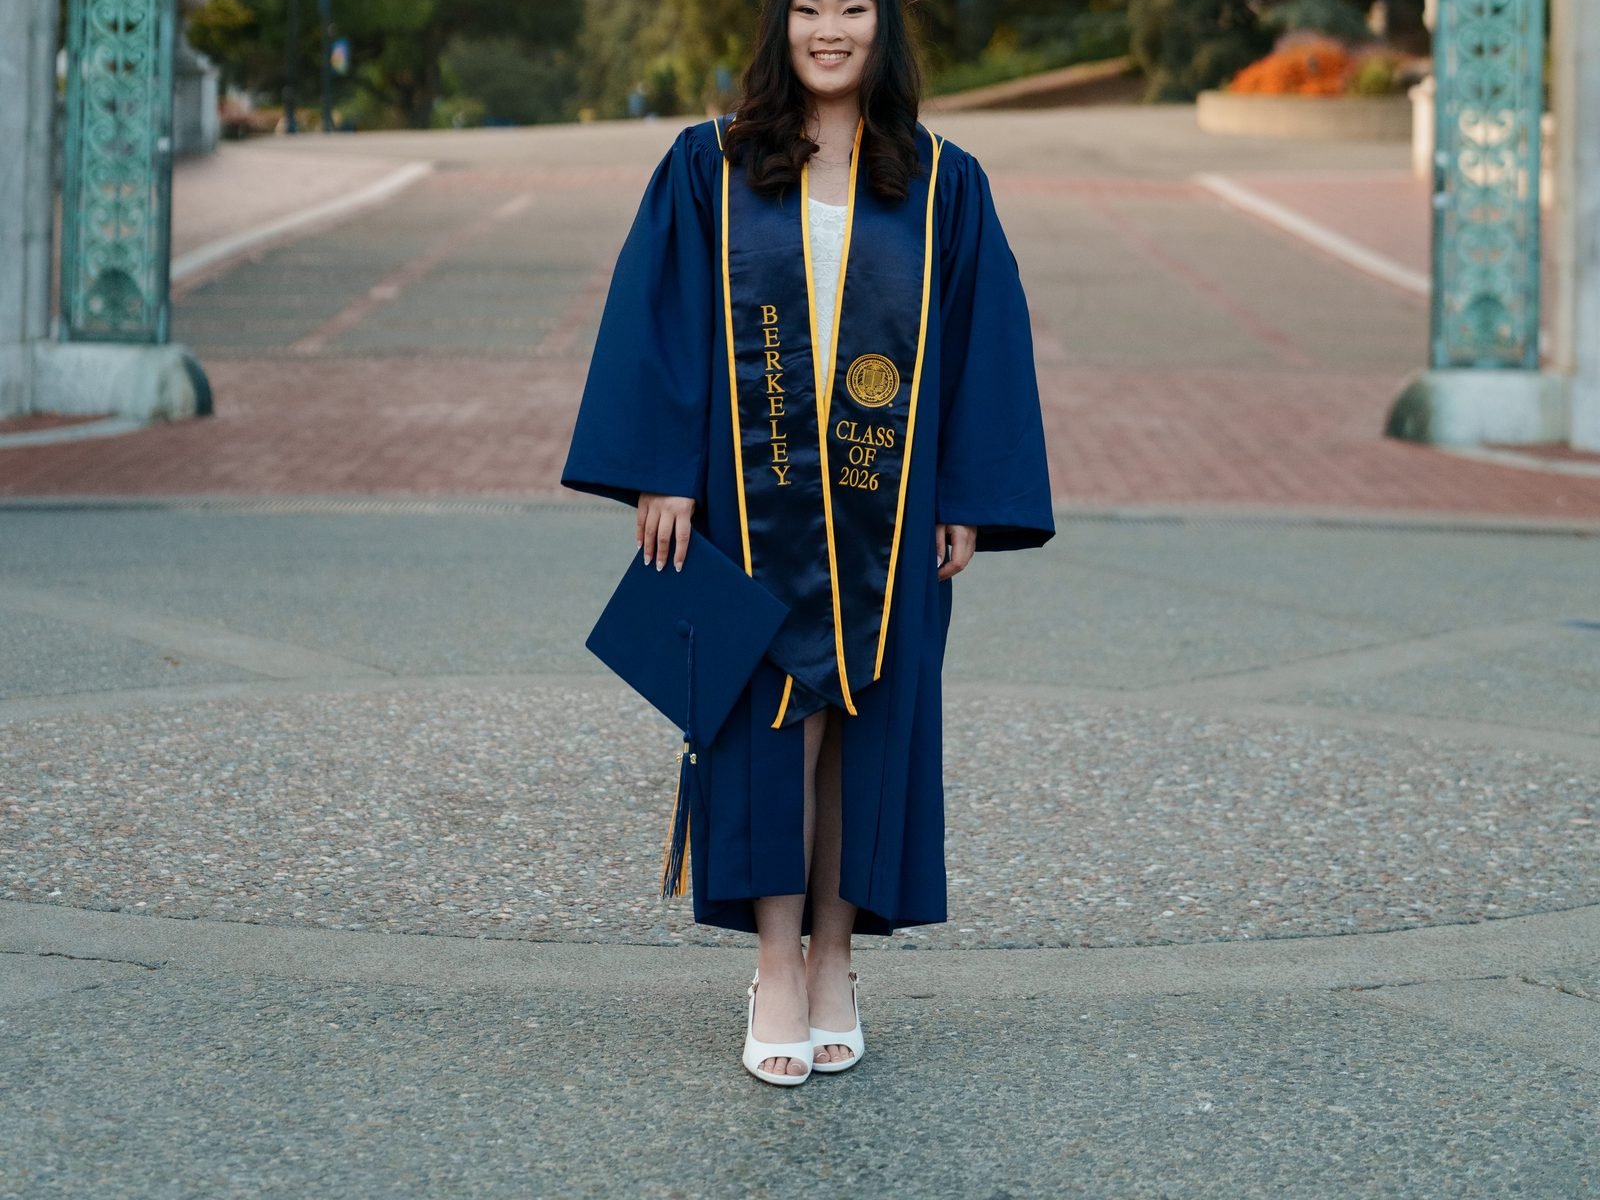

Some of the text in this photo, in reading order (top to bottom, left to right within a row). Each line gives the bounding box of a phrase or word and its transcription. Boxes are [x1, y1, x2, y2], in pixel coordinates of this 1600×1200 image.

[761, 305, 790, 485] BERKELEY
[836, 420, 895, 448] CLASS
[849, 446, 877, 467] OF
[839, 466, 880, 491] 2026
